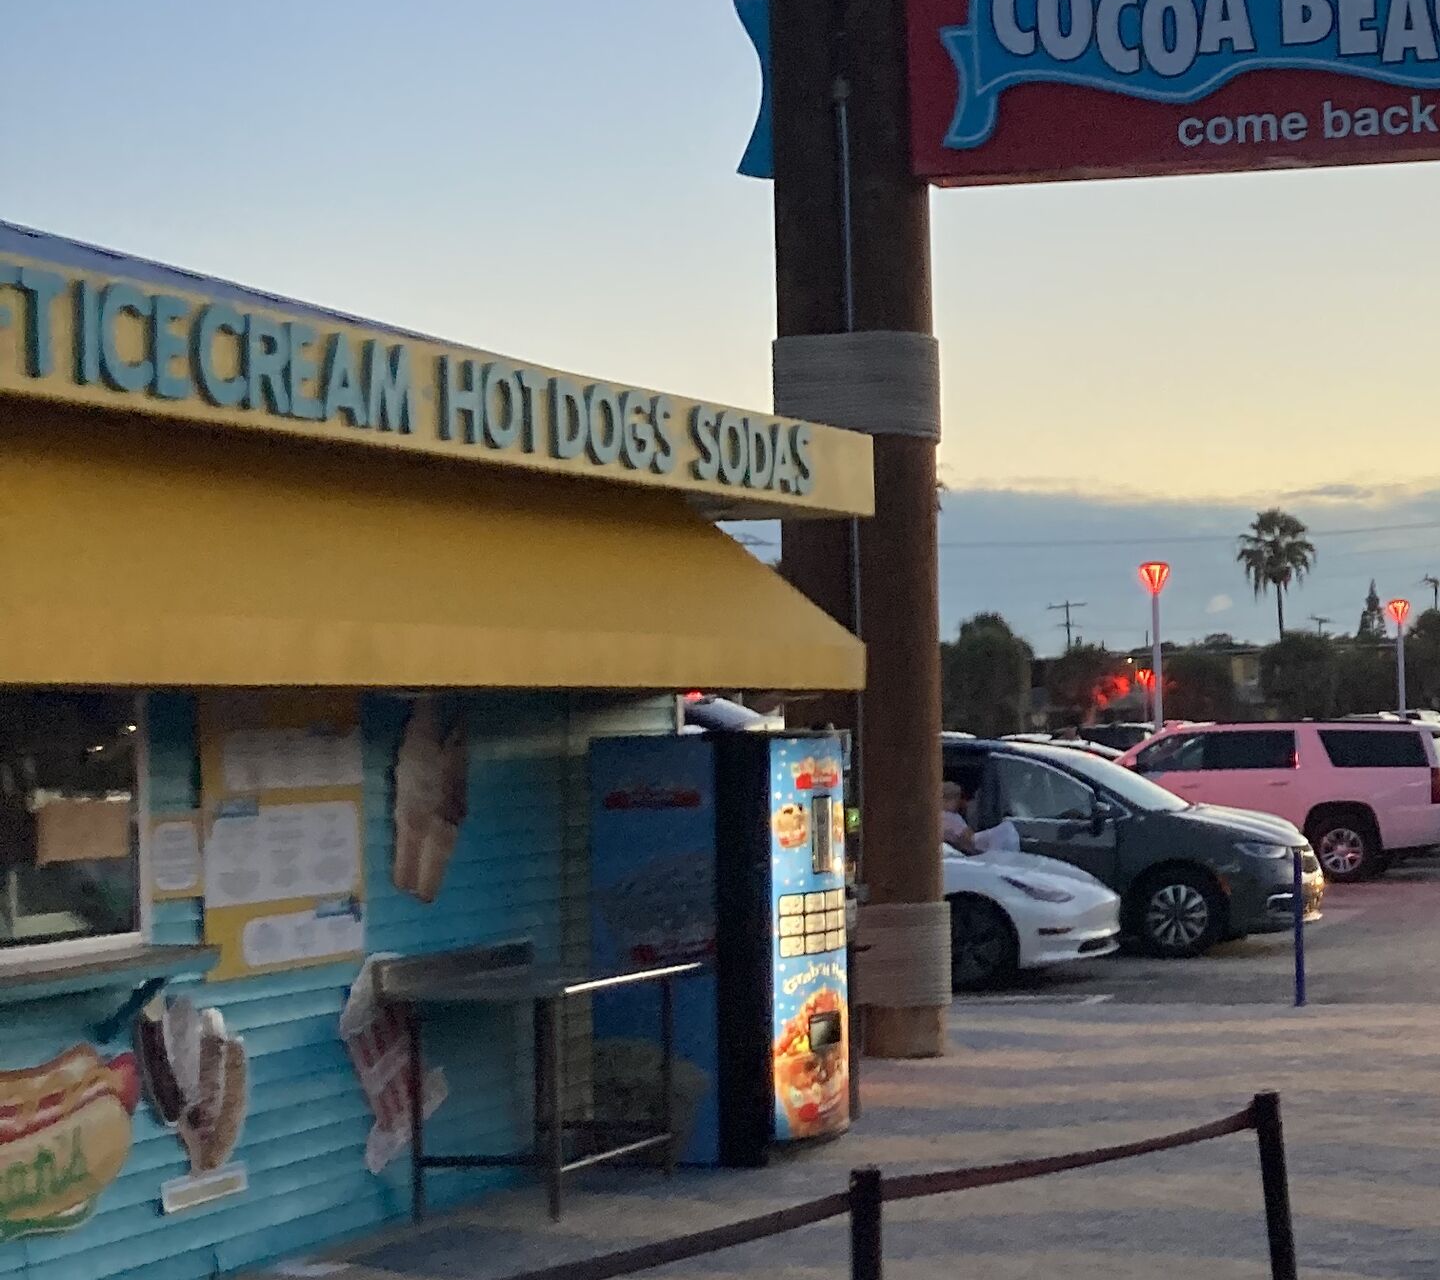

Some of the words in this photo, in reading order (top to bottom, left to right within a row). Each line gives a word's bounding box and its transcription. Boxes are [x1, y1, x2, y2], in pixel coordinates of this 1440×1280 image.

[1176, 108, 1309, 148] come
[1322, 99, 1437, 139] back
[688, 403, 816, 496] SODAS
